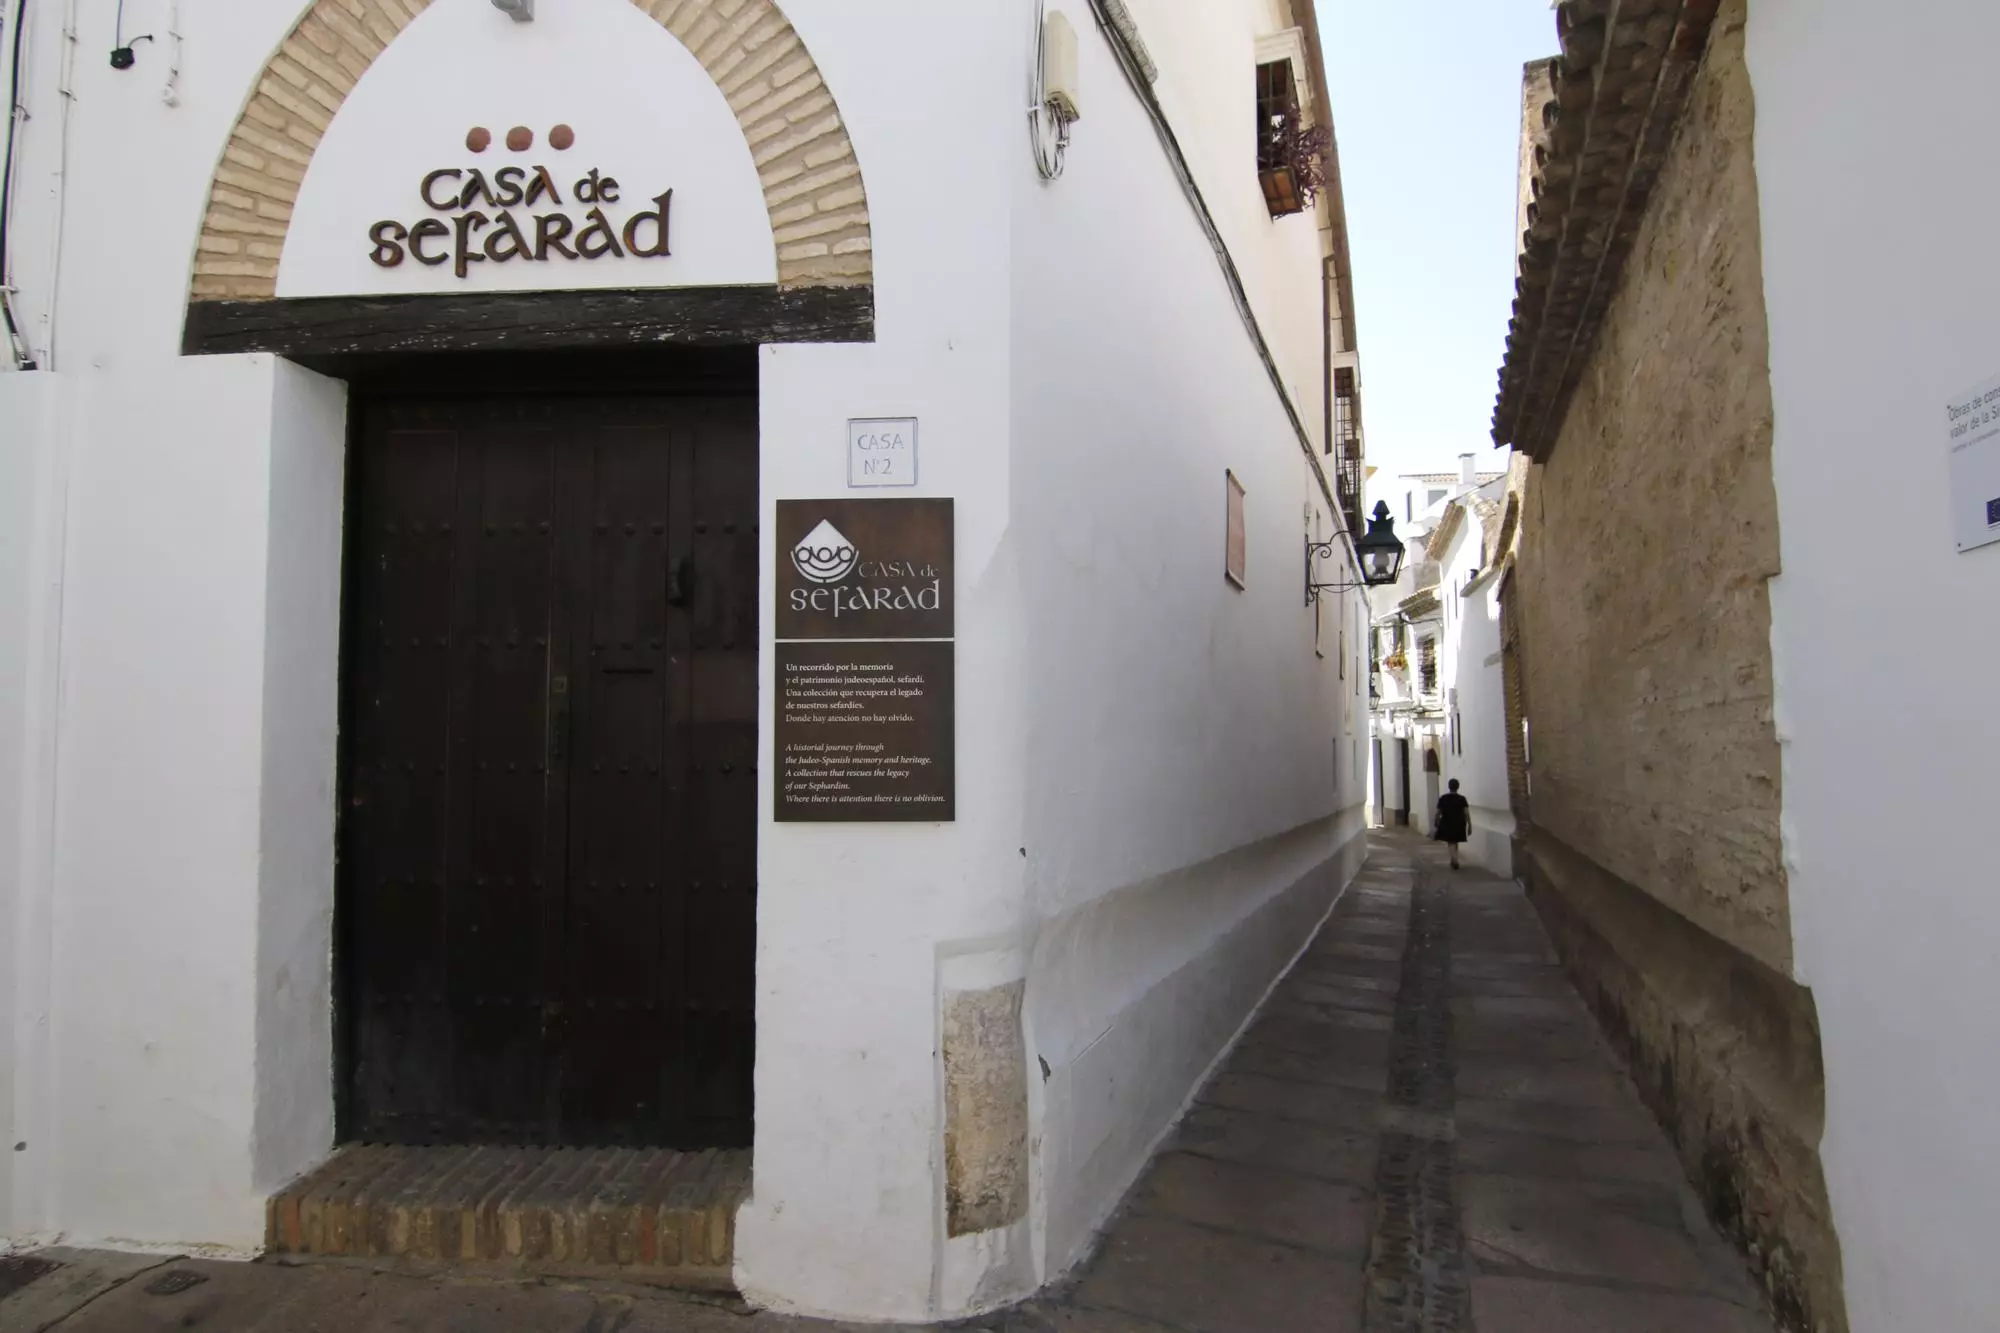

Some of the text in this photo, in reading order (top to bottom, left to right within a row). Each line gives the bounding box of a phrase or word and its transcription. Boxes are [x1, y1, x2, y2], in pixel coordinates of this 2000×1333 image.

[420, 165, 620, 211] CASA de
[1948, 402, 1970, 421] Obras
[1972, 396, 1982, 410] de
[1950, 422, 1968, 440] valor
[1970, 416, 1980, 430] de
[1981, 411, 1990, 424] la
[858, 433, 905, 450] CASA
[858, 561, 940, 578] CASA de
[836, 665, 849, 673] por
[786, 678, 790, 686] y
[800, 676, 842, 685] patrimonio
[856, 690, 888, 698] recupera
[898, 688, 924, 698] legado
[813, 714, 825, 724] hay
[874, 714, 886, 724] hay
[825, 744, 853, 753] journey
[856, 743, 884, 752] through
[798, 756, 850, 765] Judeo-Spanish
[900, 756, 932, 765] heritage.
[887, 769, 910, 778] legacy
[785, 782, 793, 790] of
[808, 782, 850, 790] Sephardim.
